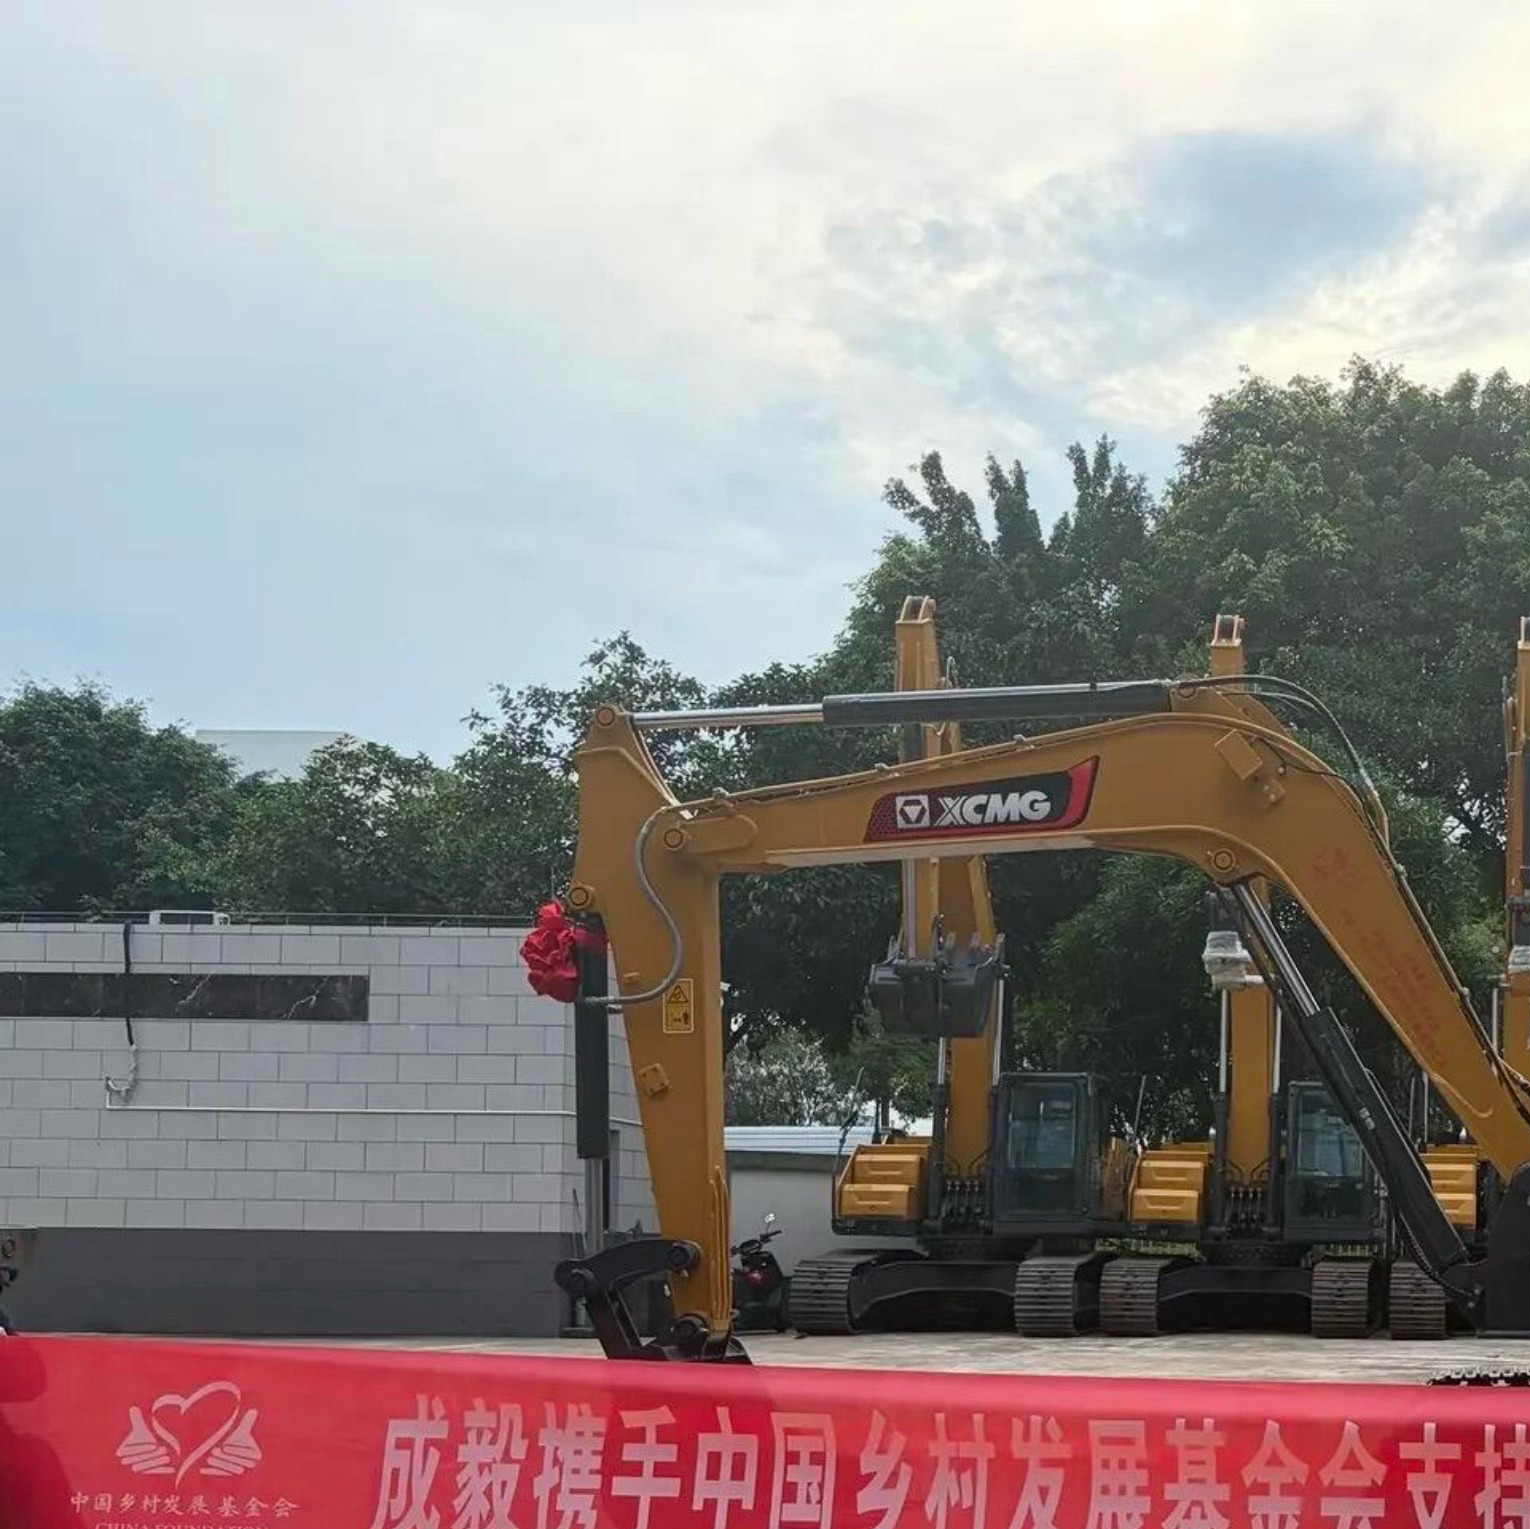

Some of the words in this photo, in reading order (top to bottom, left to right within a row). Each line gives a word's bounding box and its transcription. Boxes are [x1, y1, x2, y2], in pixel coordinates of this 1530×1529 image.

[934, 790, 1051, 827] XCMG
[70, 1491, 299, 1517] 中国乡村发展基金会
